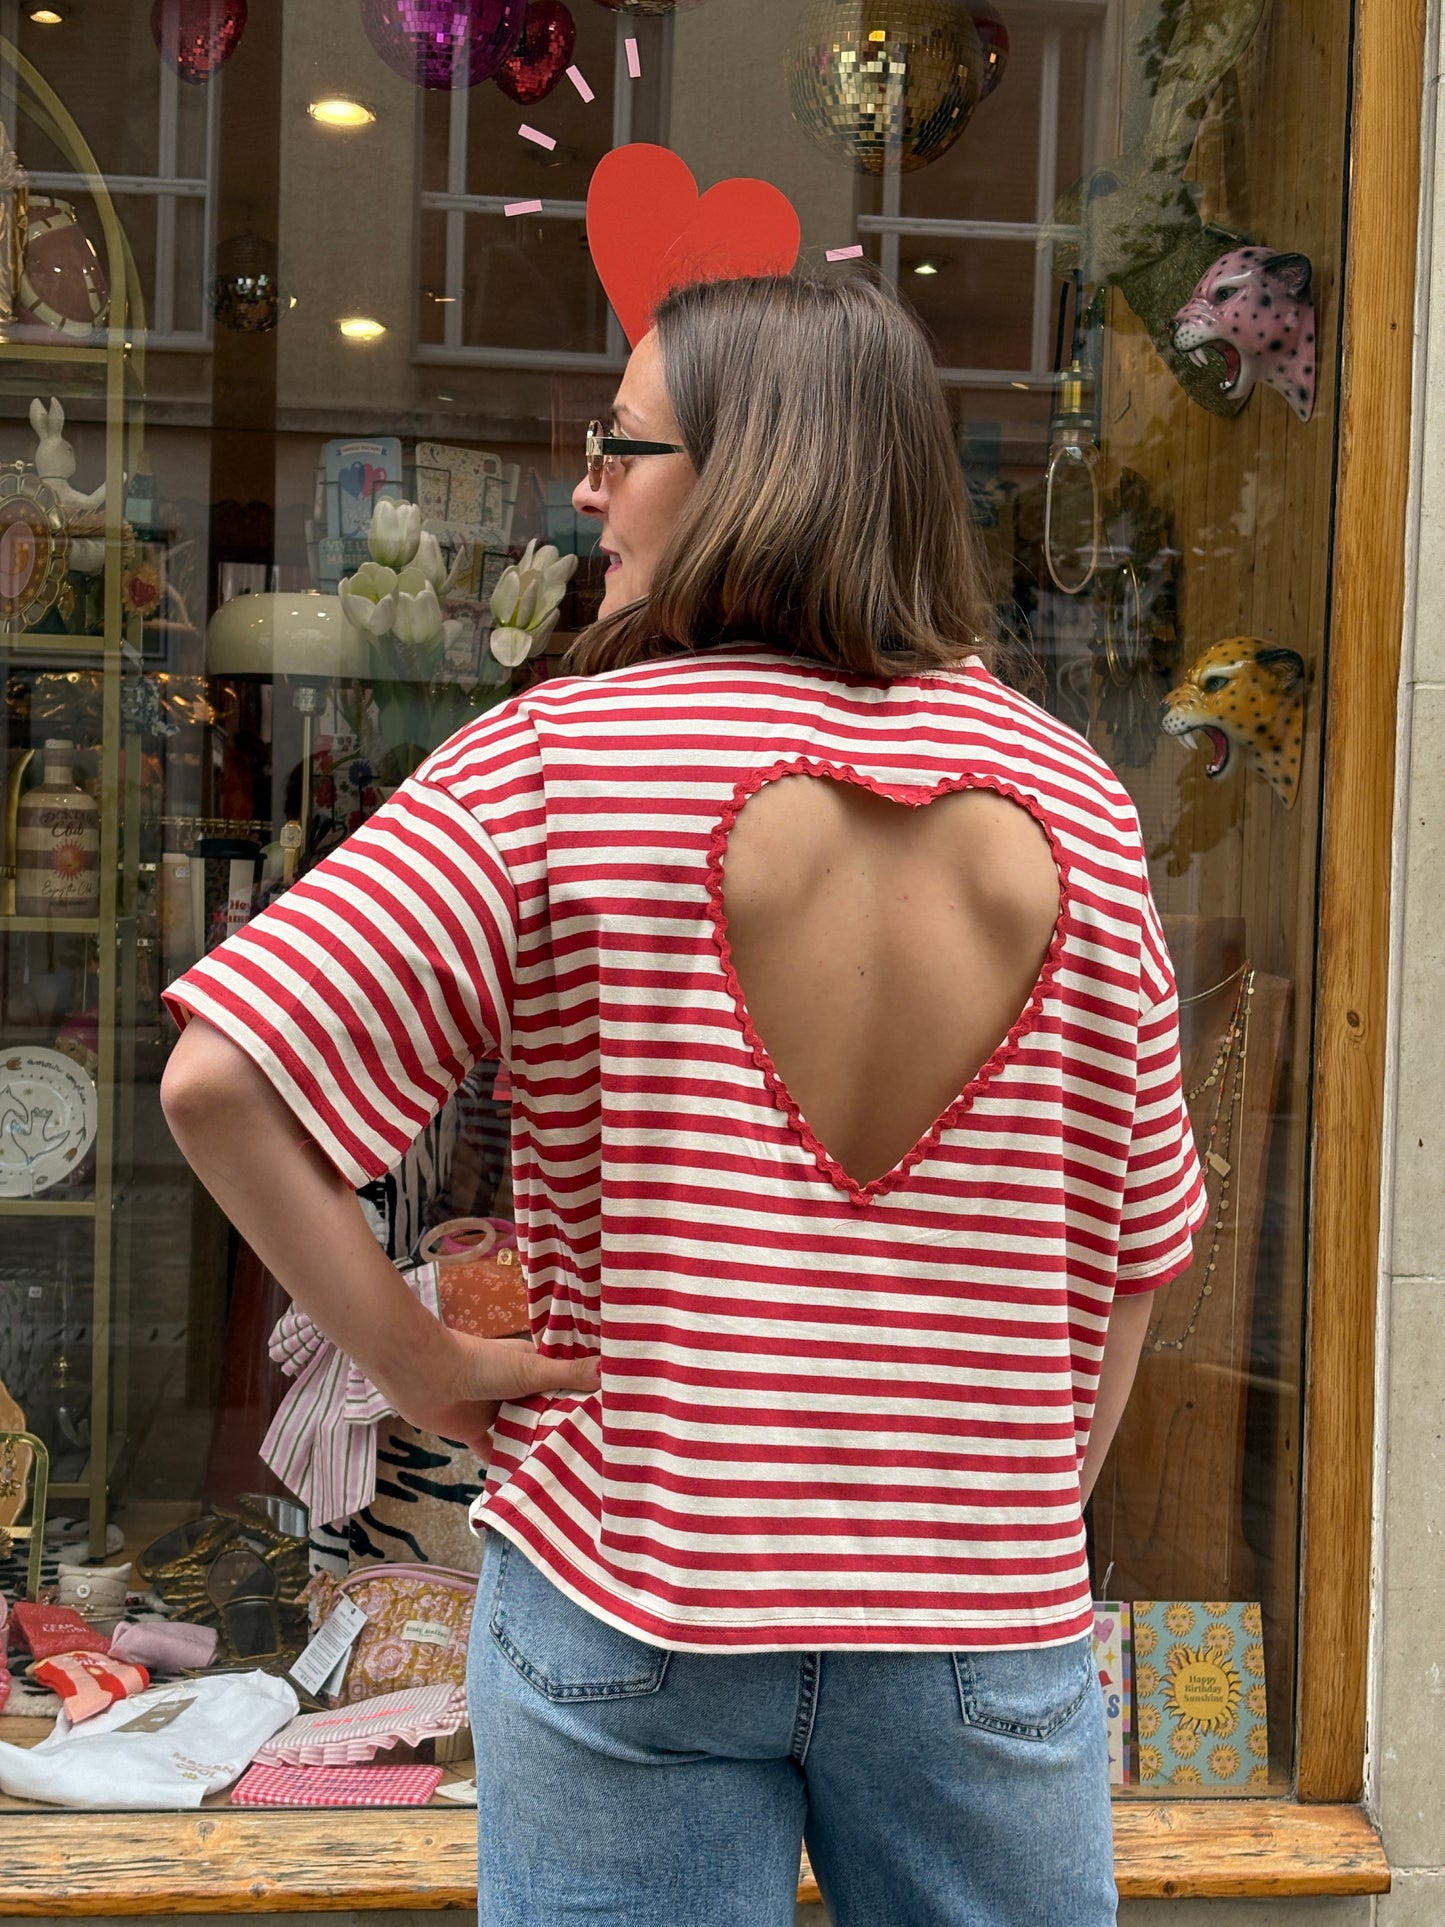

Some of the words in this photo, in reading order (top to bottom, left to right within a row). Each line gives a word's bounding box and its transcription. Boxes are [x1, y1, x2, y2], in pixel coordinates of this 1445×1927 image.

[52, 822, 84, 838] Club
[1189, 1675, 1217, 1685] Happy
[1184, 1684, 1222, 1694] Birthday
[1184, 1694, 1223, 1703] Sunshine
[173, 1751, 237, 1775] MAMAN
[176, 1762, 217, 1779] COOL
